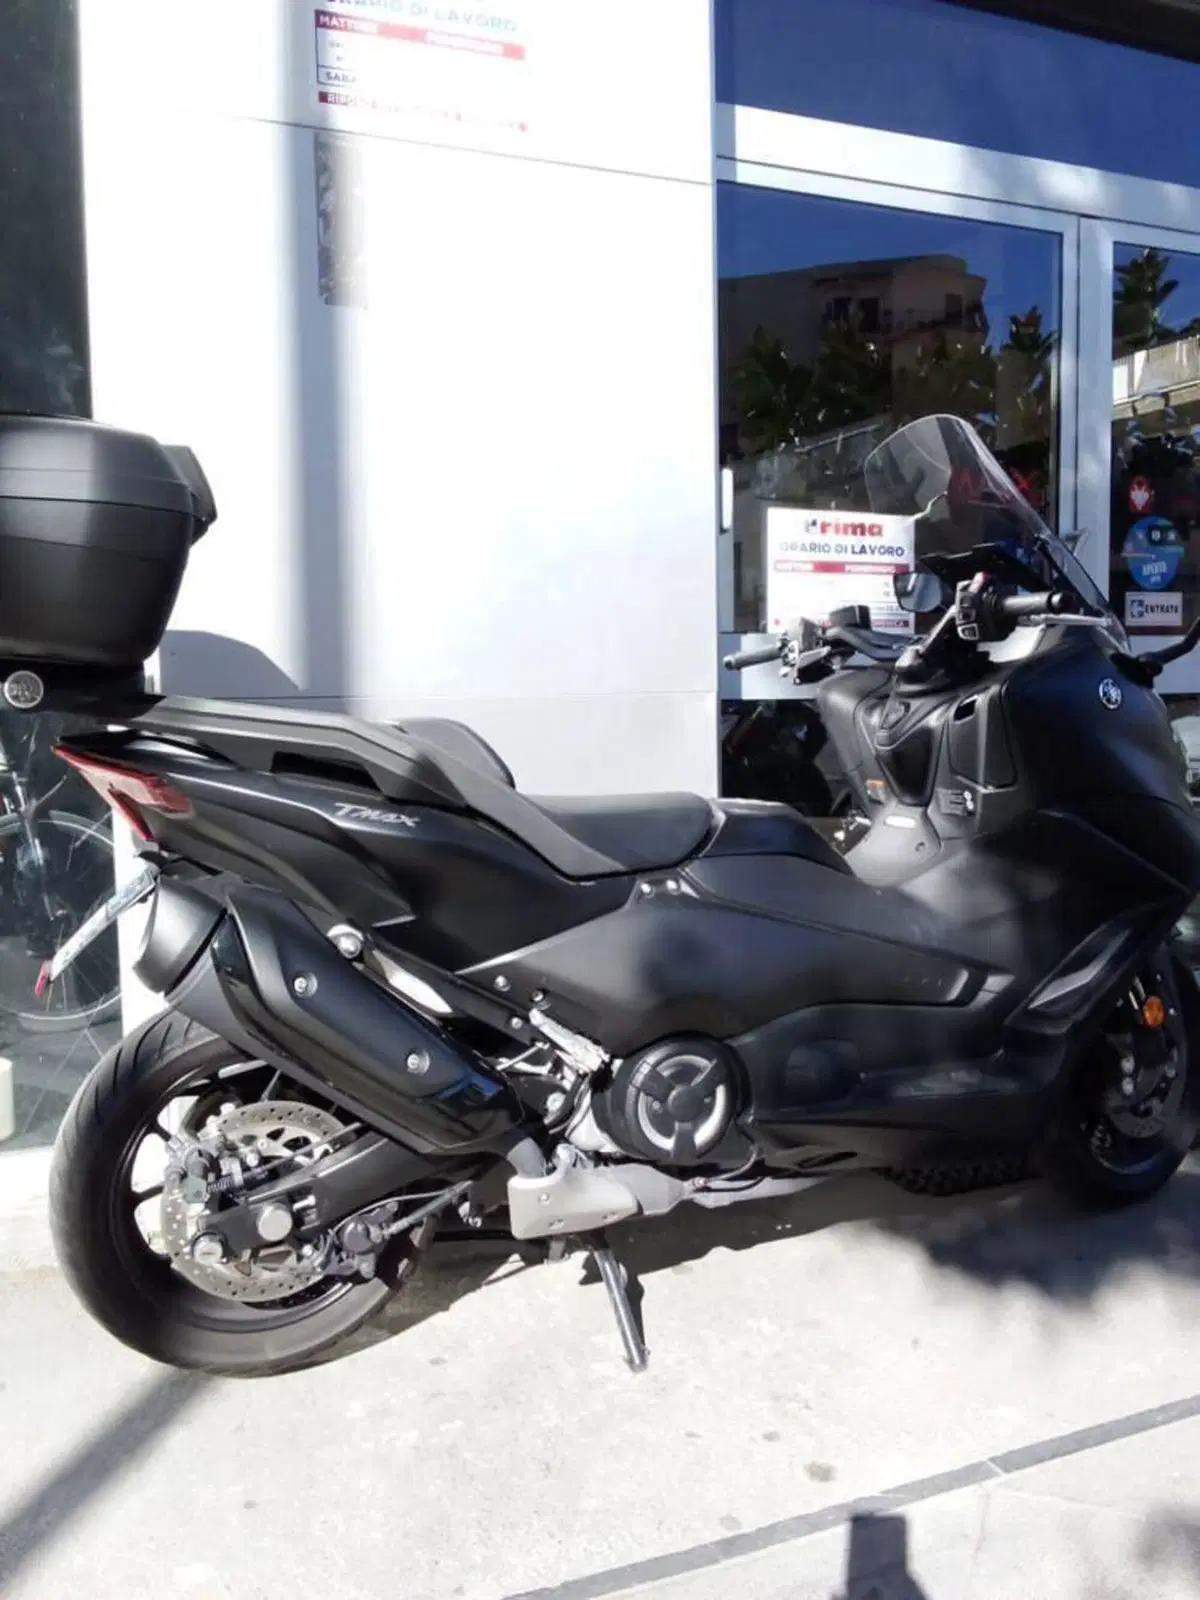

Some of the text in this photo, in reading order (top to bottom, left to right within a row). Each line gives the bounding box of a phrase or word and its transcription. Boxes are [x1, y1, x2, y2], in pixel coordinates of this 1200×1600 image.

[435, 8, 519, 32] LAVORO
[779, 541, 905, 558] ORARIO DI LAVORO
